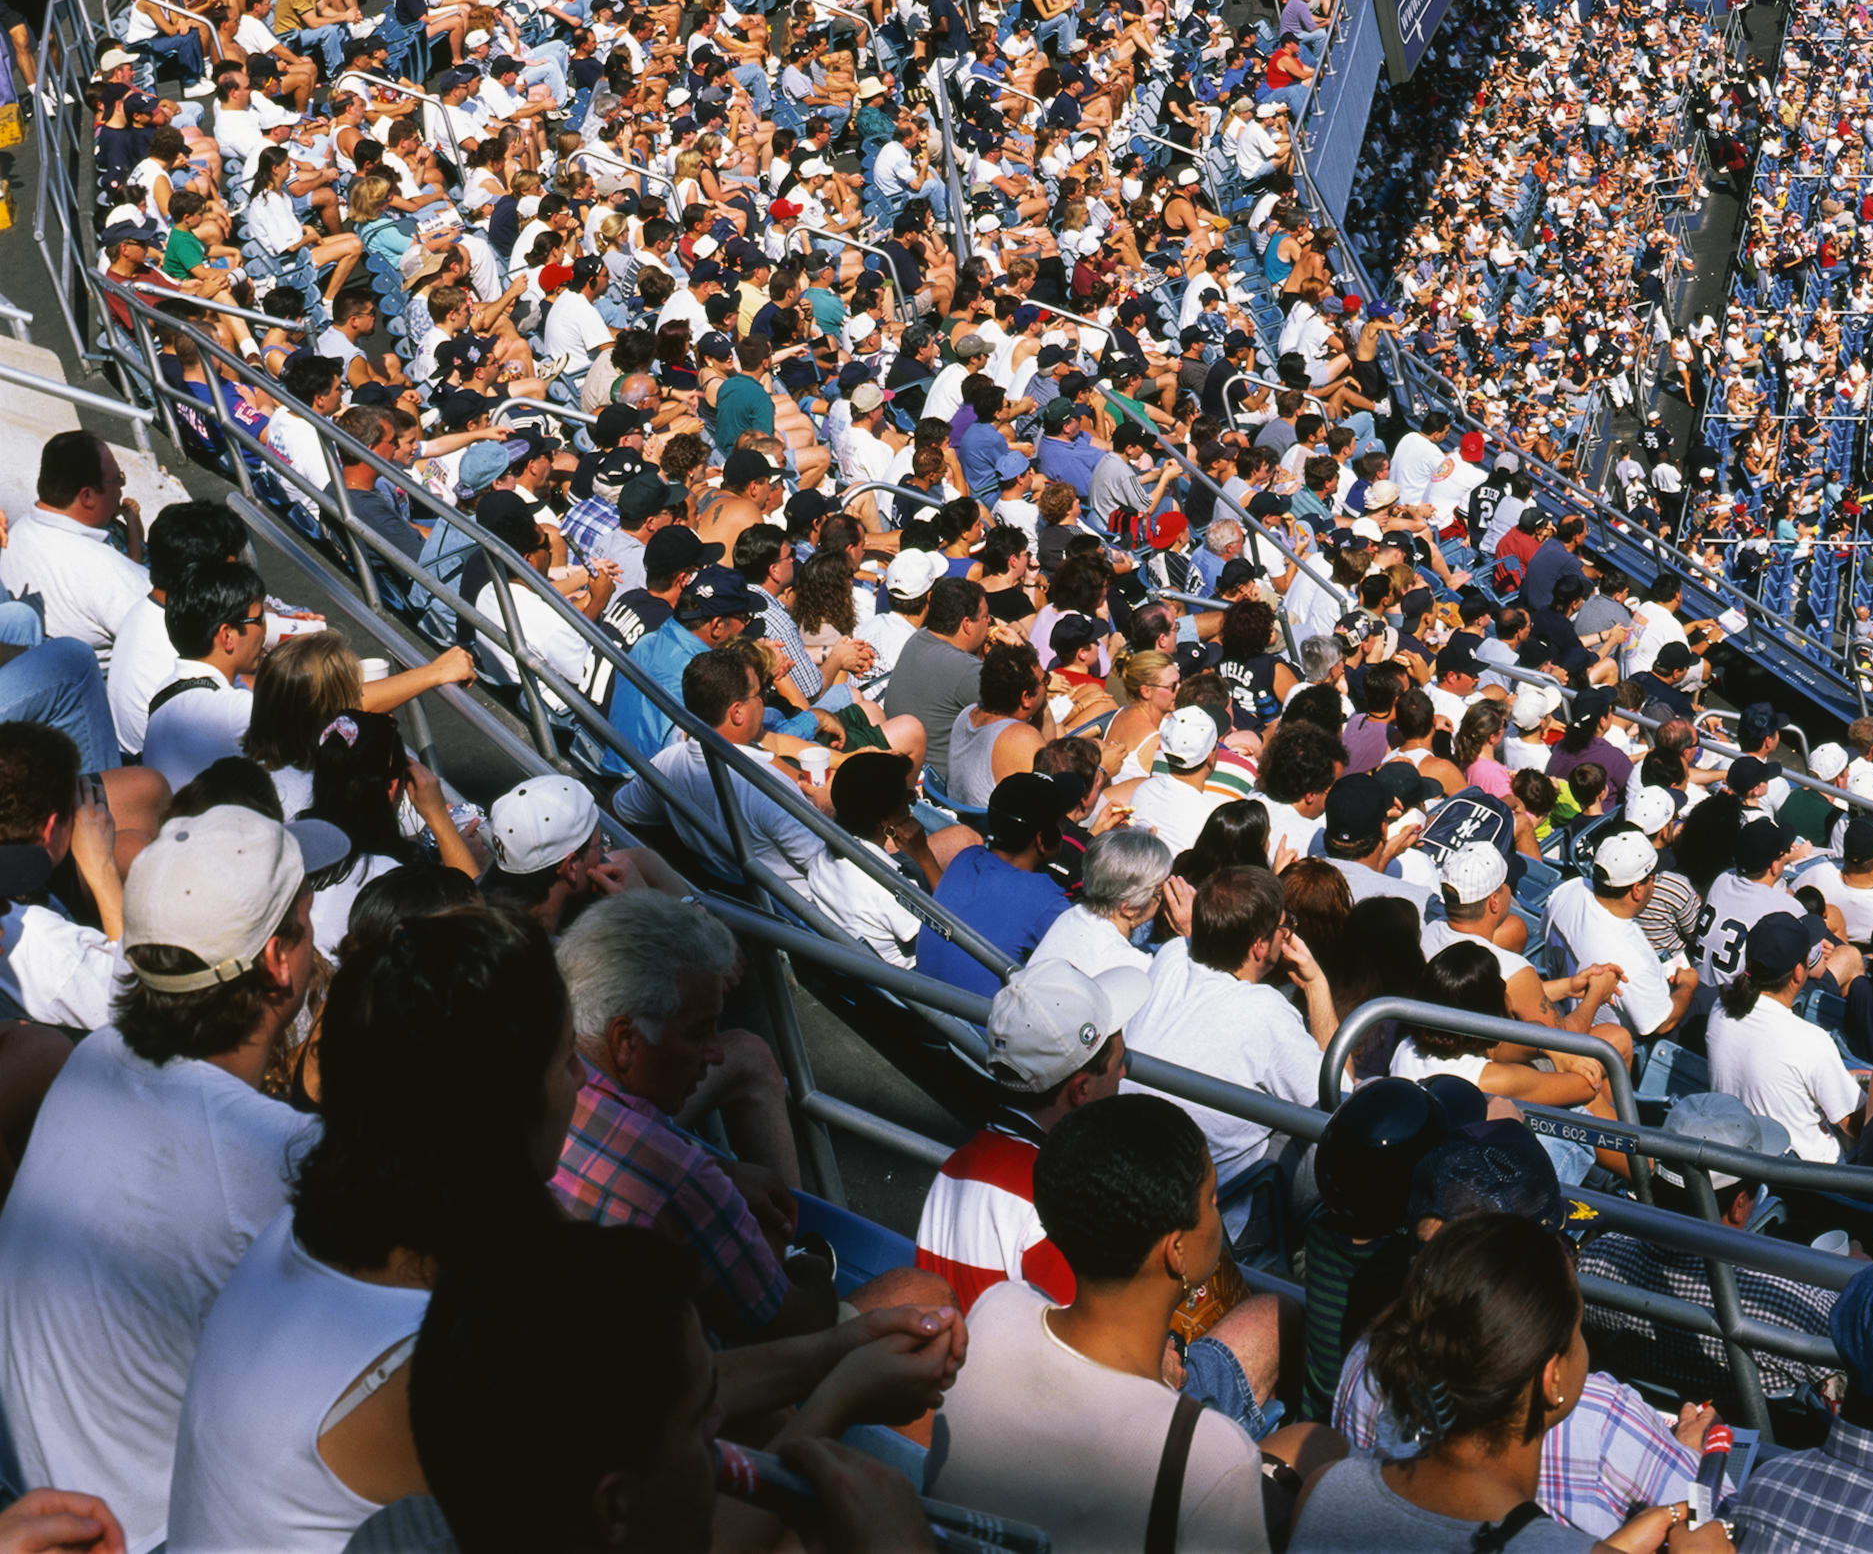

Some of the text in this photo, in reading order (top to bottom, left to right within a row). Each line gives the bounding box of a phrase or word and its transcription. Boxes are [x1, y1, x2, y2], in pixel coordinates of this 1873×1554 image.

[1477, 485, 1499, 503] JETER
[1531, 1117, 1624, 1149] BOX 602 A-F
